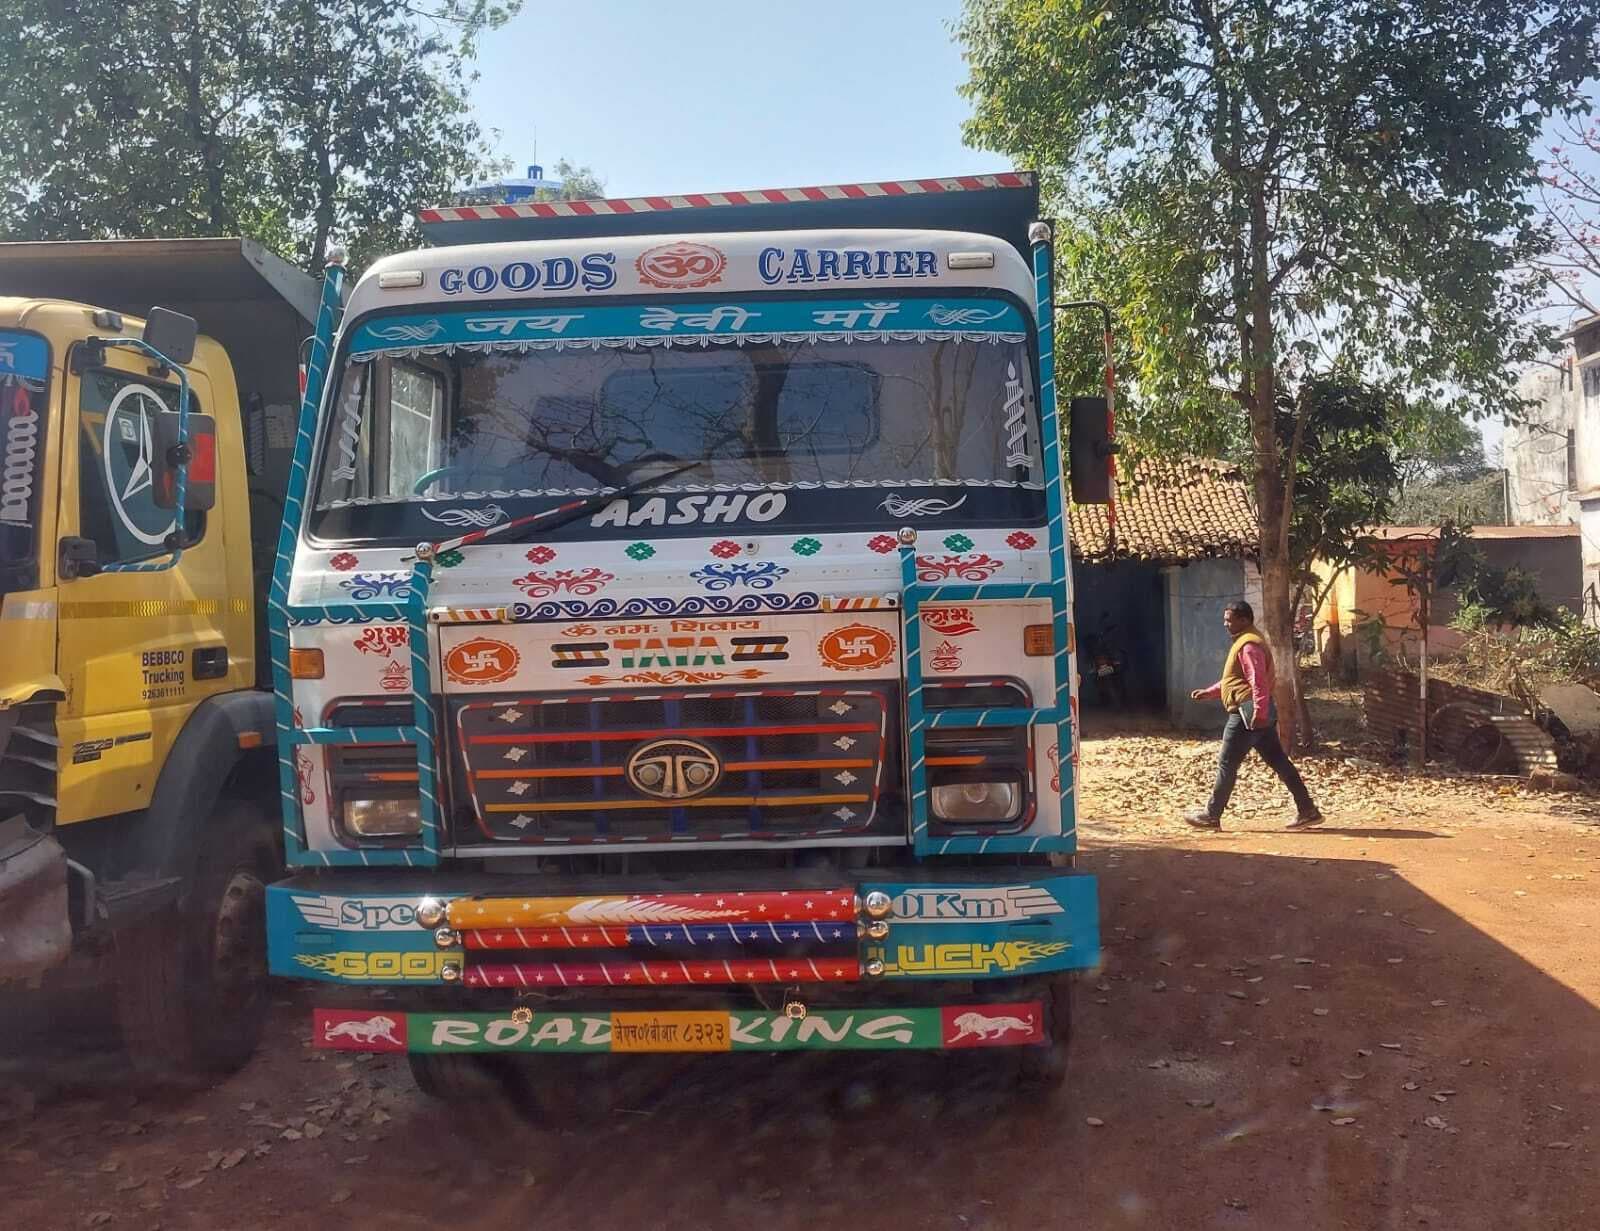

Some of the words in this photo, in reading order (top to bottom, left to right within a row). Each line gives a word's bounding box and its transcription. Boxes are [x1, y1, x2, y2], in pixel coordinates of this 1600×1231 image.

[439, 252, 617, 295] GOODS
[758, 247, 939, 285] CARRIER
[465, 314, 584, 335] जय
[640, 305, 762, 331] देवी
[812, 302, 900, 329] माँ
[591, 492, 787, 529] AASHO
[670, 620, 761, 633] शिवाय
[142, 650, 185, 667] BEBBCO
[613, 636, 726, 668] TATA
[142, 670, 185, 685] Trucking
[340, 901, 438, 929] Spe
[880, 894, 1008, 919] 0Km
[867, 943, 1012, 976] LUCK
[432, 1016, 611, 1046] ROAD
[729, 1014, 914, 1046] KING
[682, 1022, 725, 1045] ८३२३
